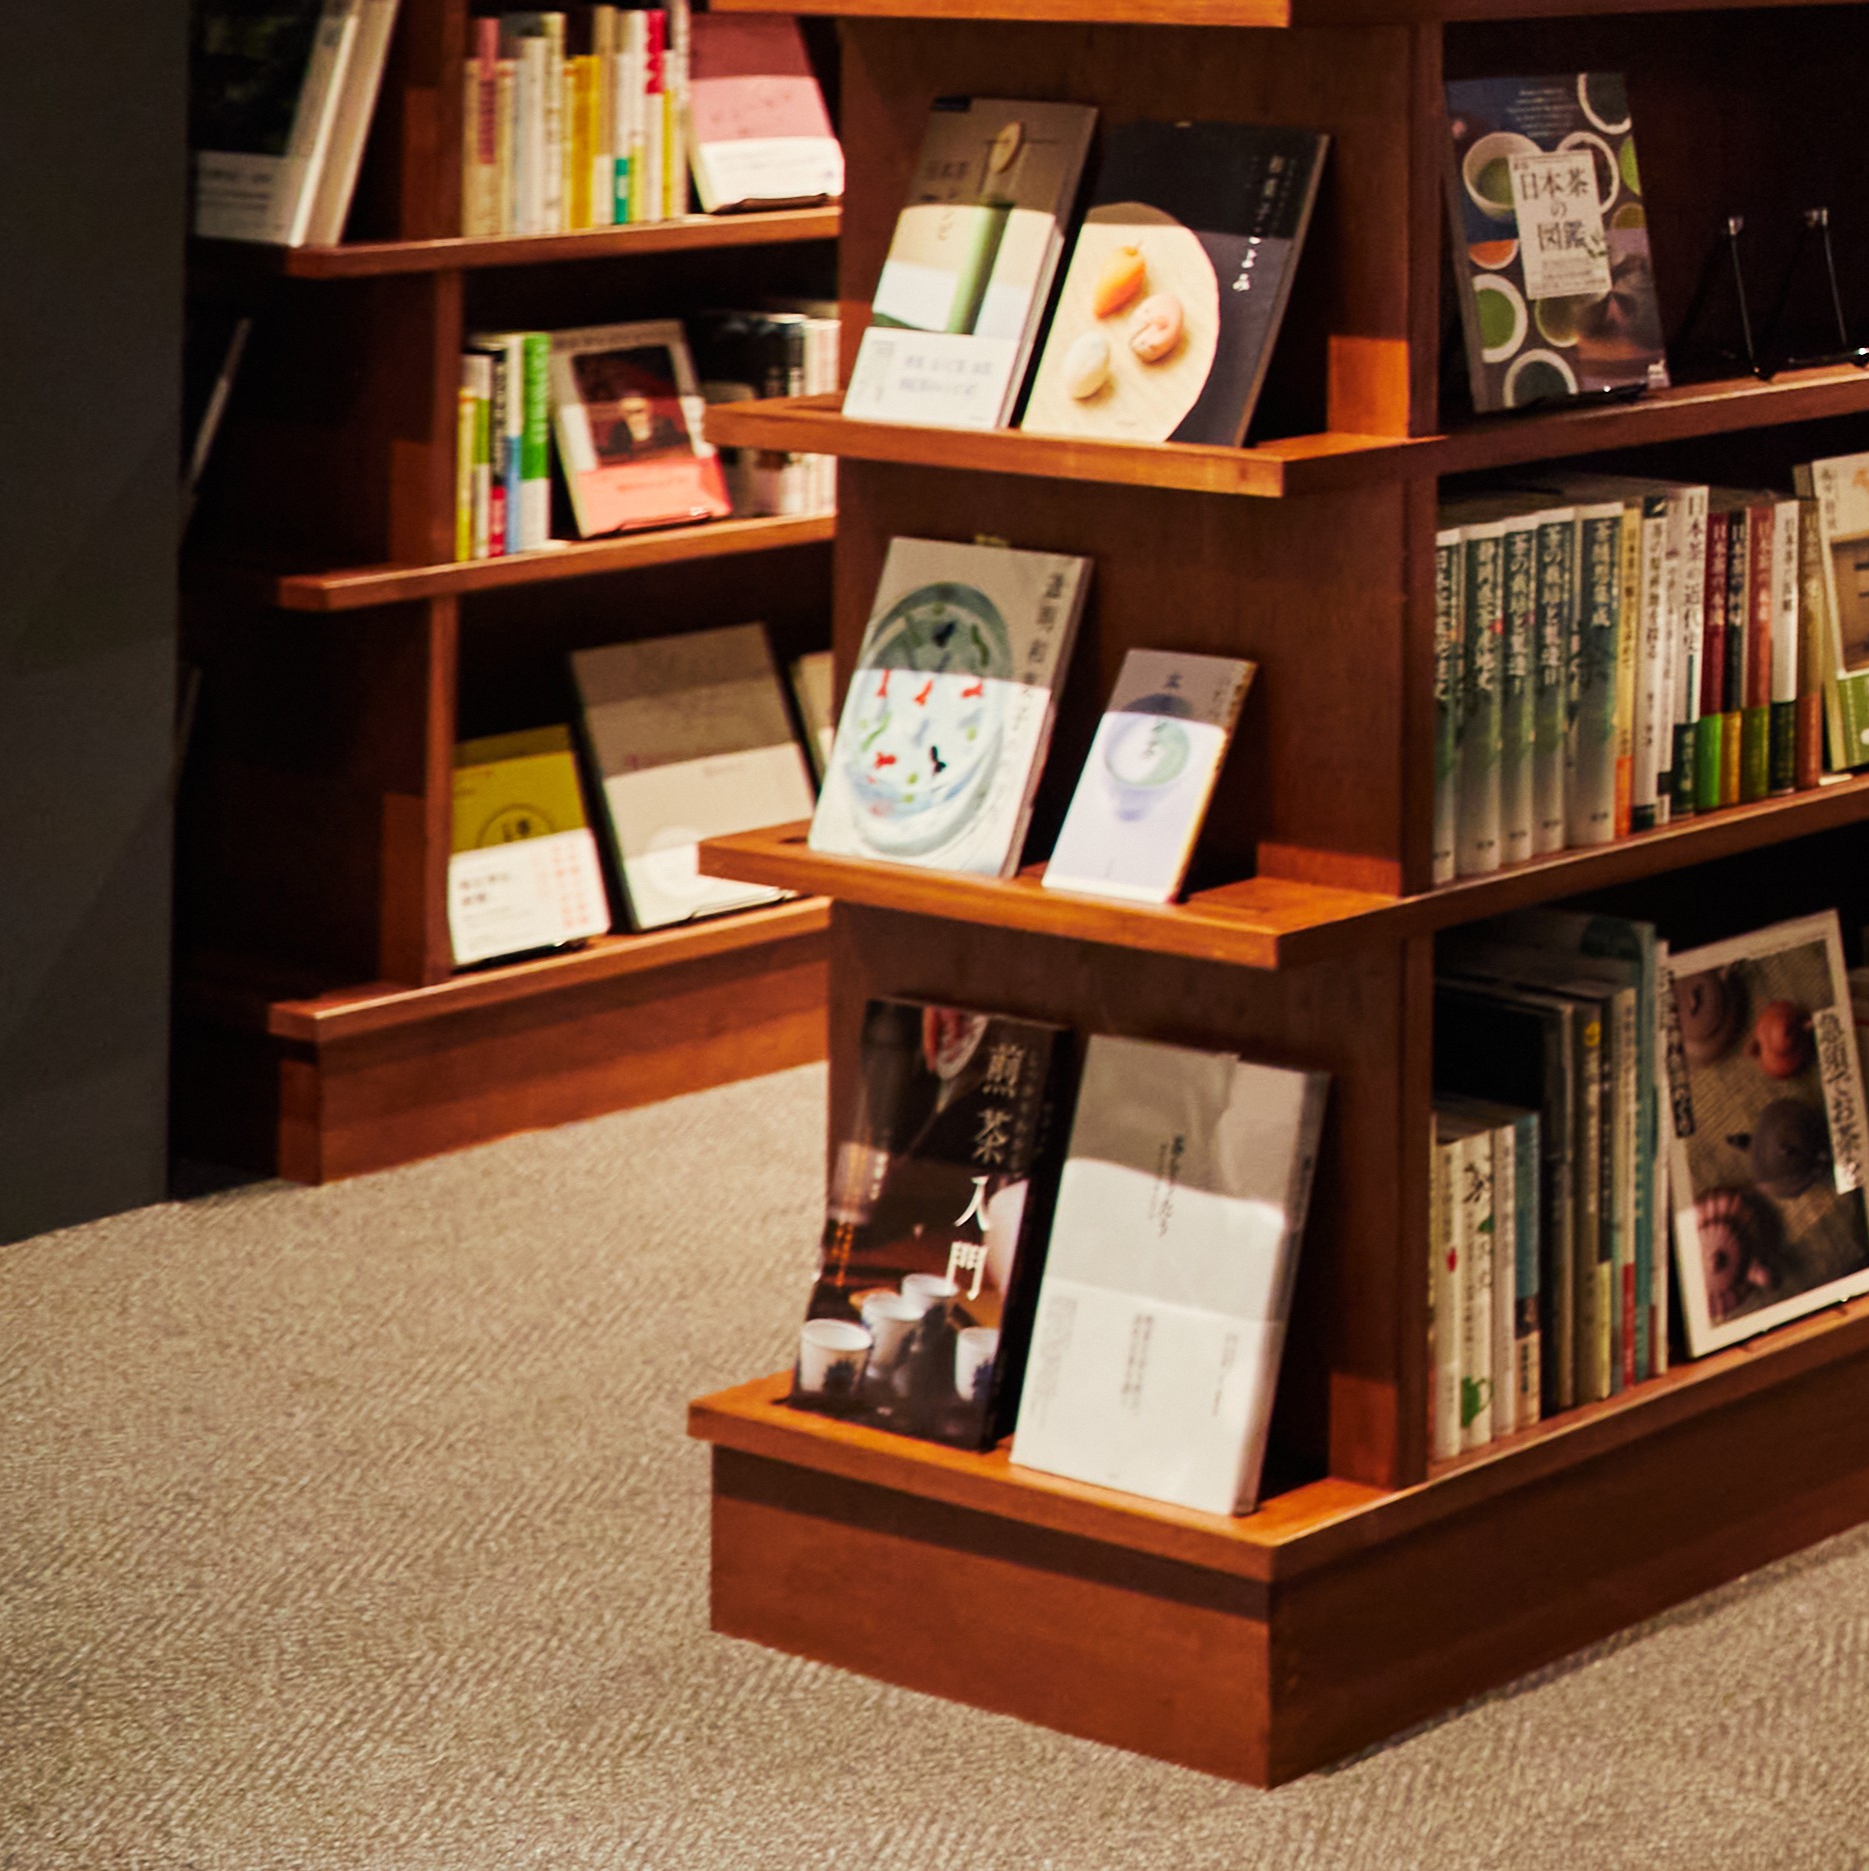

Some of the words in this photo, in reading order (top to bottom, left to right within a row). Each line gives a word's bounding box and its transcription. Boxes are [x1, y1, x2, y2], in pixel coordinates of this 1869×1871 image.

[1520, 168, 1589, 201] 日本茶
[1550, 202, 1568, 217] の
[946, 1043, 1024, 1301] 煎茶入門
